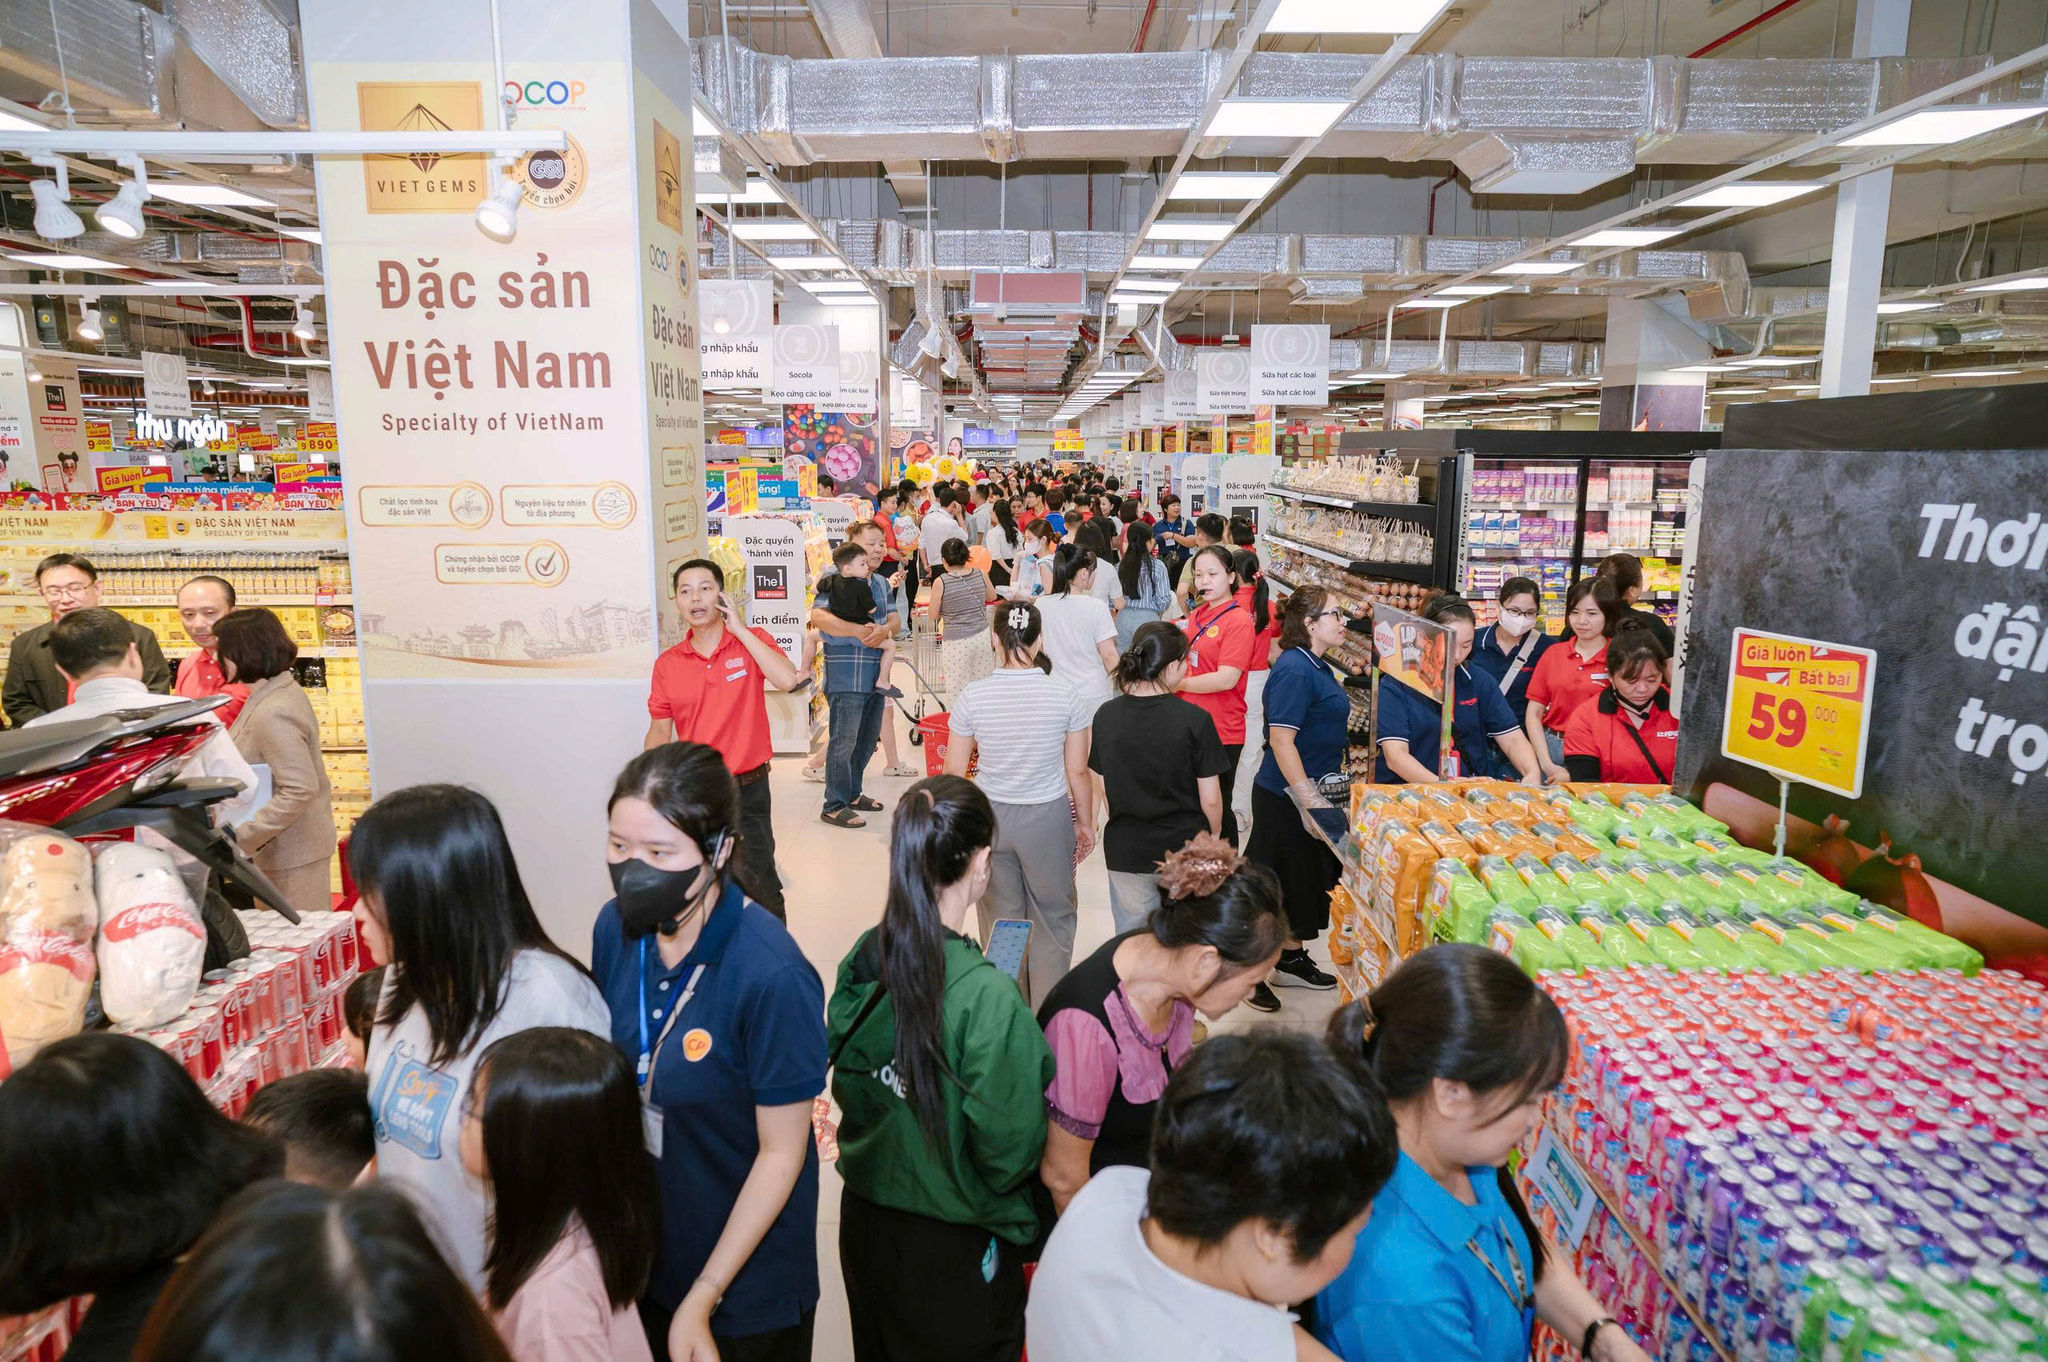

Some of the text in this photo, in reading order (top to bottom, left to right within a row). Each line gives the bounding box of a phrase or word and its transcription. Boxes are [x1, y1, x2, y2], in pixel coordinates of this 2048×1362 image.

[504, 80, 587, 105] OCOP
[376, 252, 591, 321] Đặc sản
[652, 303, 695, 350] Đặc sản
[709, 343, 734, 355] nhập
[735, 340, 759, 354] khẩu
[363, 338, 612, 401] Việt Nam
[710, 369, 733, 380] nhập
[736, 366, 759, 379] khẩu
[788, 371, 813, 379] Socola
[1262, 370, 1317, 381] Sữa hạt các loại
[650, 361, 699, 407] Việt Nam
[770, 389, 784, 399] Kẹo
[785, 389, 804, 400] cứng
[805, 389, 817, 398] các
[818, 389, 832, 399] loại
[1261, 388, 1316, 398] Sữa hạt các loại
[136, 410, 173, 441] thu
[177, 413, 228, 448] ngân
[381, 412, 604, 436] Specialty of VietNam
[309, 439, 333, 450] 890
[1226, 481, 1266, 492] Đặc quyền
[1225, 492, 1265, 500] thành viên
[24, 517, 49, 528] NAM
[220, 515, 242, 528] SẢN
[244, 515, 268, 529] VIỆT
[270, 517, 296, 528] NAM
[827, 515, 850, 524] quyền
[10, 529, 44, 537] VIETNAM
[203, 529, 290, 537] SPECIALTY OF VIETNAM
[745, 535, 794, 547] Đặc quyền
[746, 548, 794, 558] hành viên
[771, 611, 800, 625] điểm
[1746, 644, 1806, 662] Giá luôn
[1799, 669, 1851, 690] Bất bại
[1746, 690, 1807, 749] 59
[1954, 697, 2048, 786] trọ
